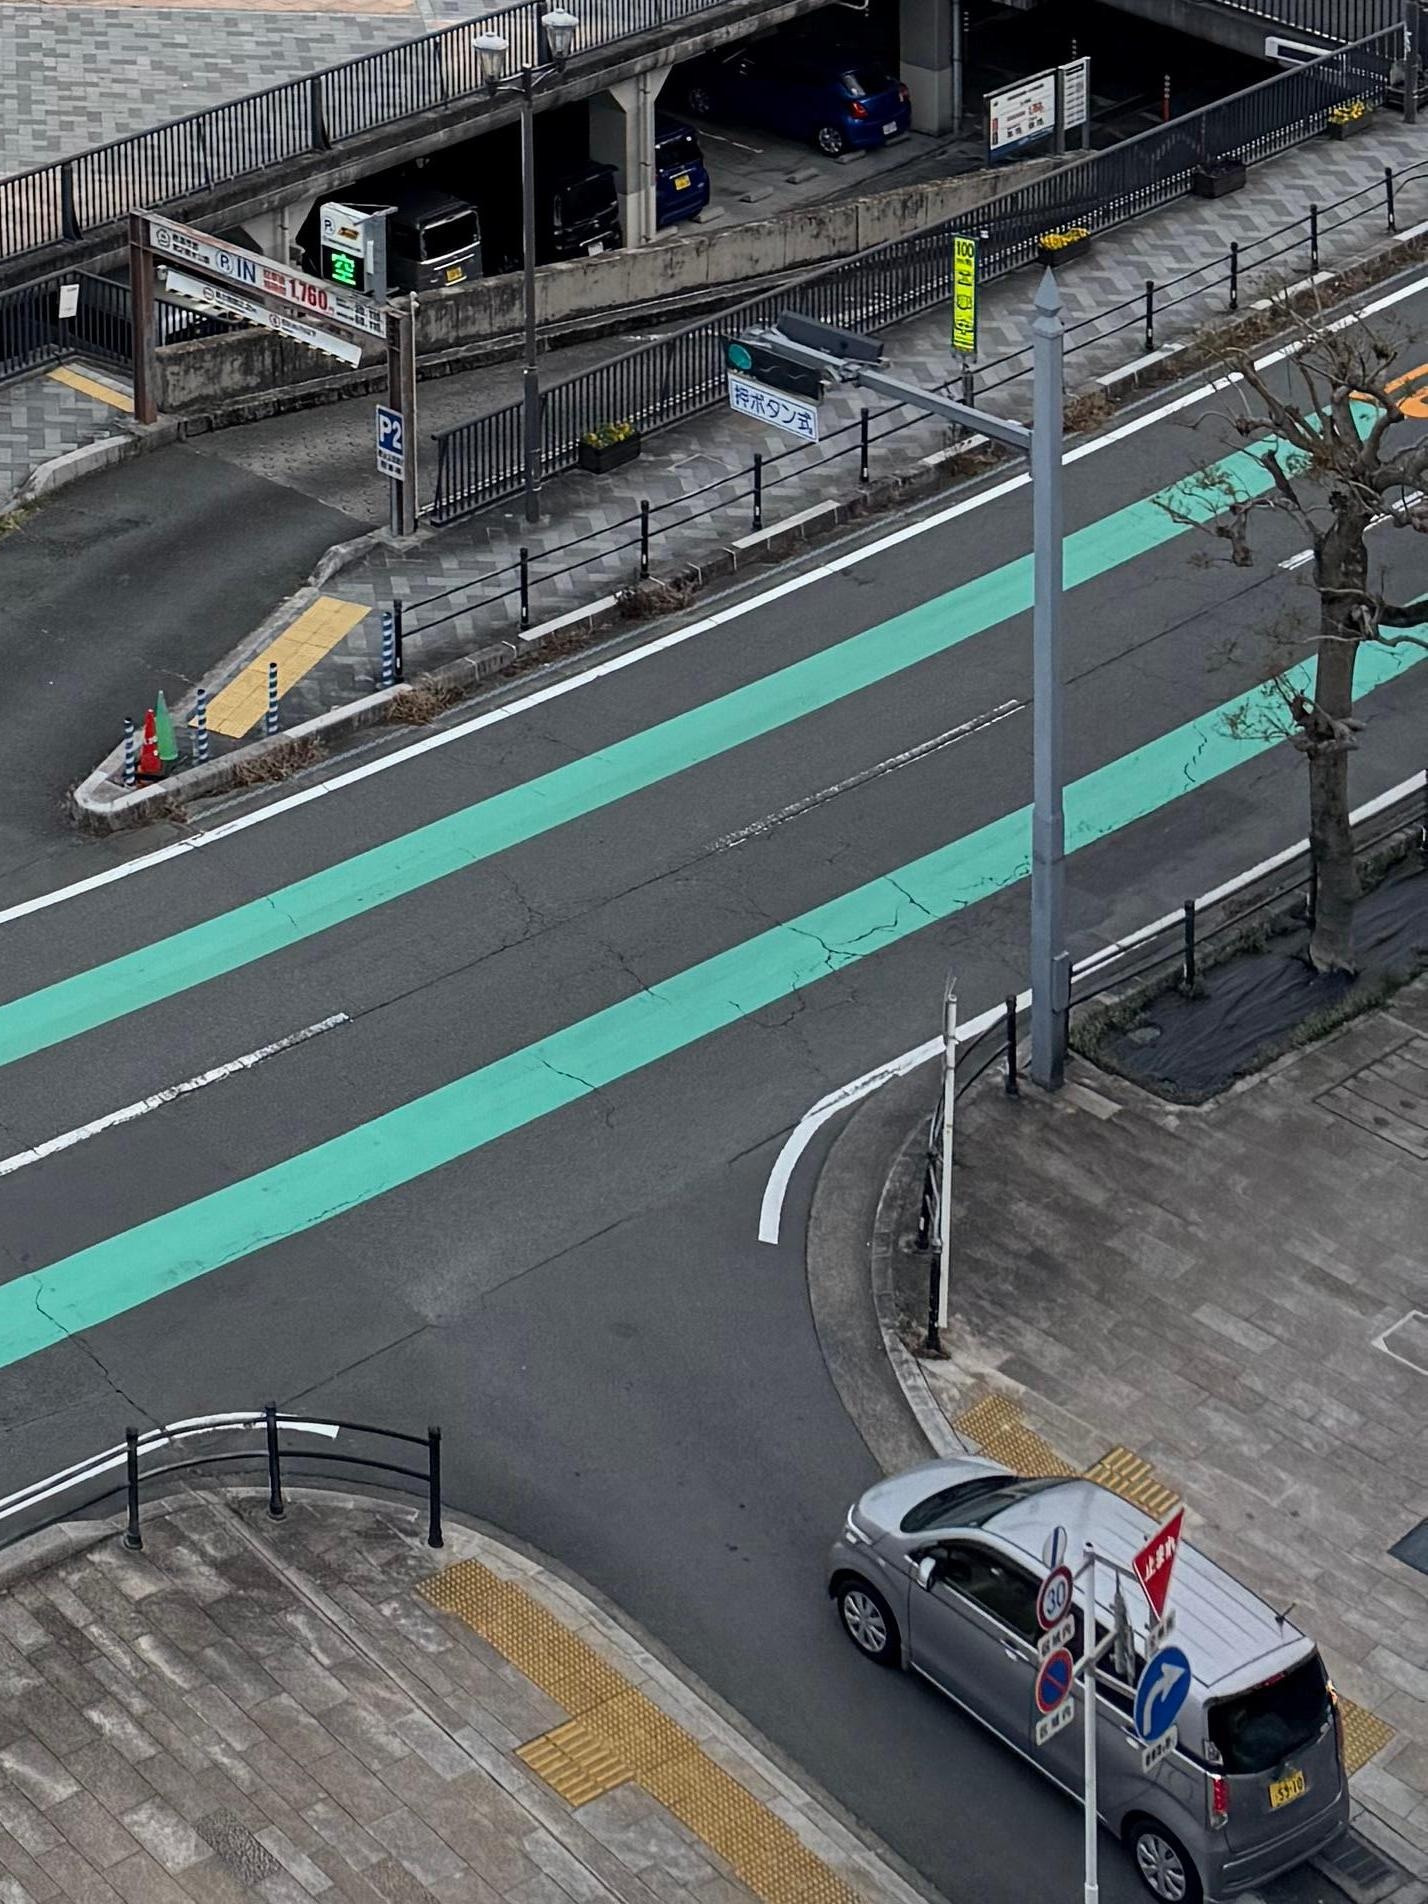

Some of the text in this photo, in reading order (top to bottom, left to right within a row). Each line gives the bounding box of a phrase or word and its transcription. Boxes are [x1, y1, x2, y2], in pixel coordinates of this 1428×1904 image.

[956, 241, 974, 258] 100
[237, 257, 256, 284] IN
[331, 253, 356, 286] 空
[734, 384, 814, 436] 押ボタン式
[380, 414, 402, 450] P2
[1145, 1535, 1176, 1582] 止まれ
[1047, 1579, 1066, 1616] 30
